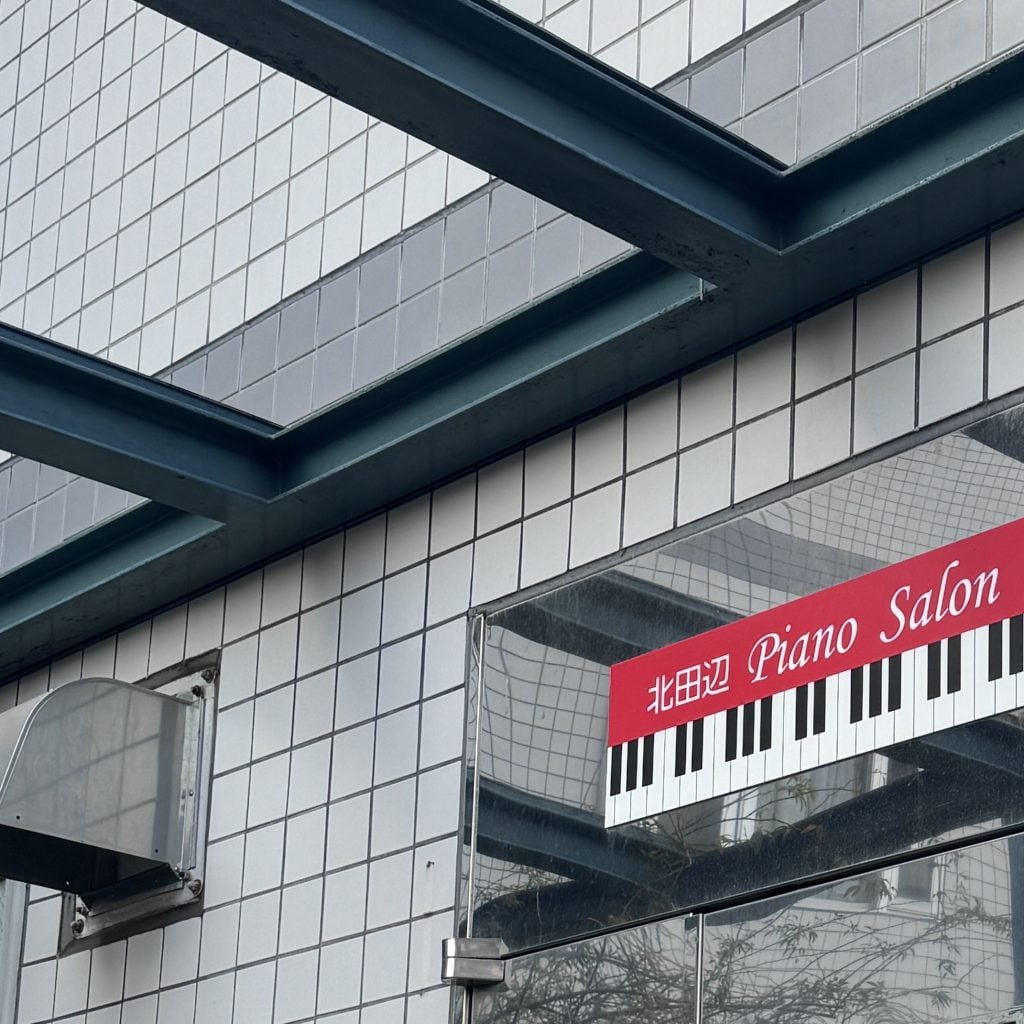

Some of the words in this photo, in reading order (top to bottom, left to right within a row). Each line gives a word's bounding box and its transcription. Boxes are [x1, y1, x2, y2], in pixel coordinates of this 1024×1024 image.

[647, 653, 730, 714] 北田辺
[748, 617, 858, 683] Piano
[880, 560, 1000, 644] Salon
